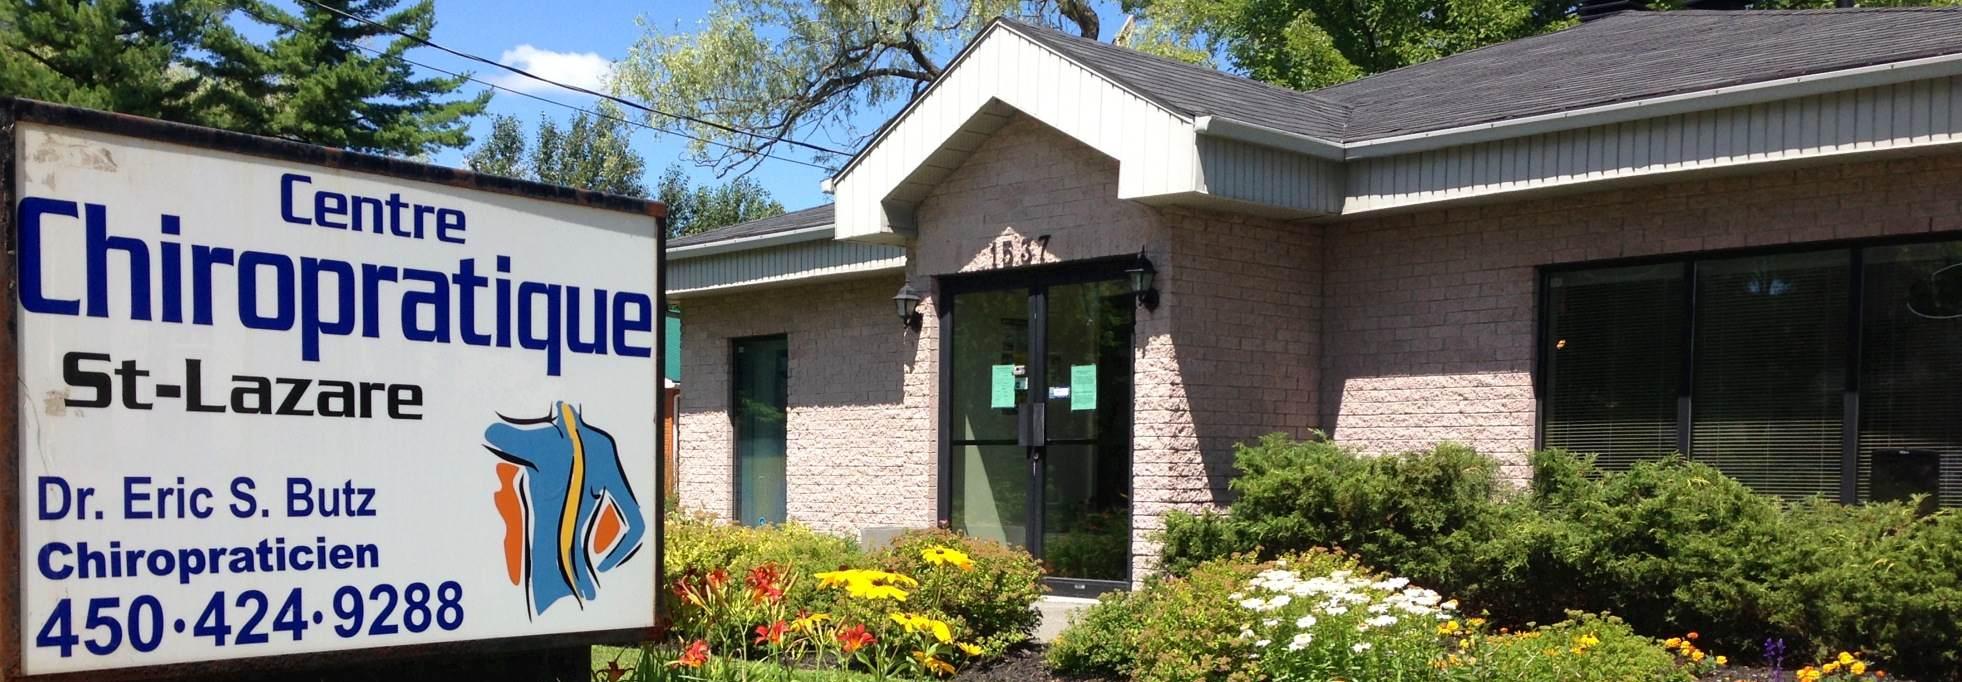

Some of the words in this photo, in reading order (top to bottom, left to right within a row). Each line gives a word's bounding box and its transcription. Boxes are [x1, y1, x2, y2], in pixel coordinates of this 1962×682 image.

[280, 172, 467, 245] Centre
[17, 196, 653, 377] Chiropratique
[62, 351, 424, 421] St-Lazare
[37, 475, 104, 521] Dr.
[123, 476, 214, 520] Eric
[229, 476, 269, 520] S.
[286, 477, 377, 518] Butz
[37, 536, 379, 585] Chiropraticien
